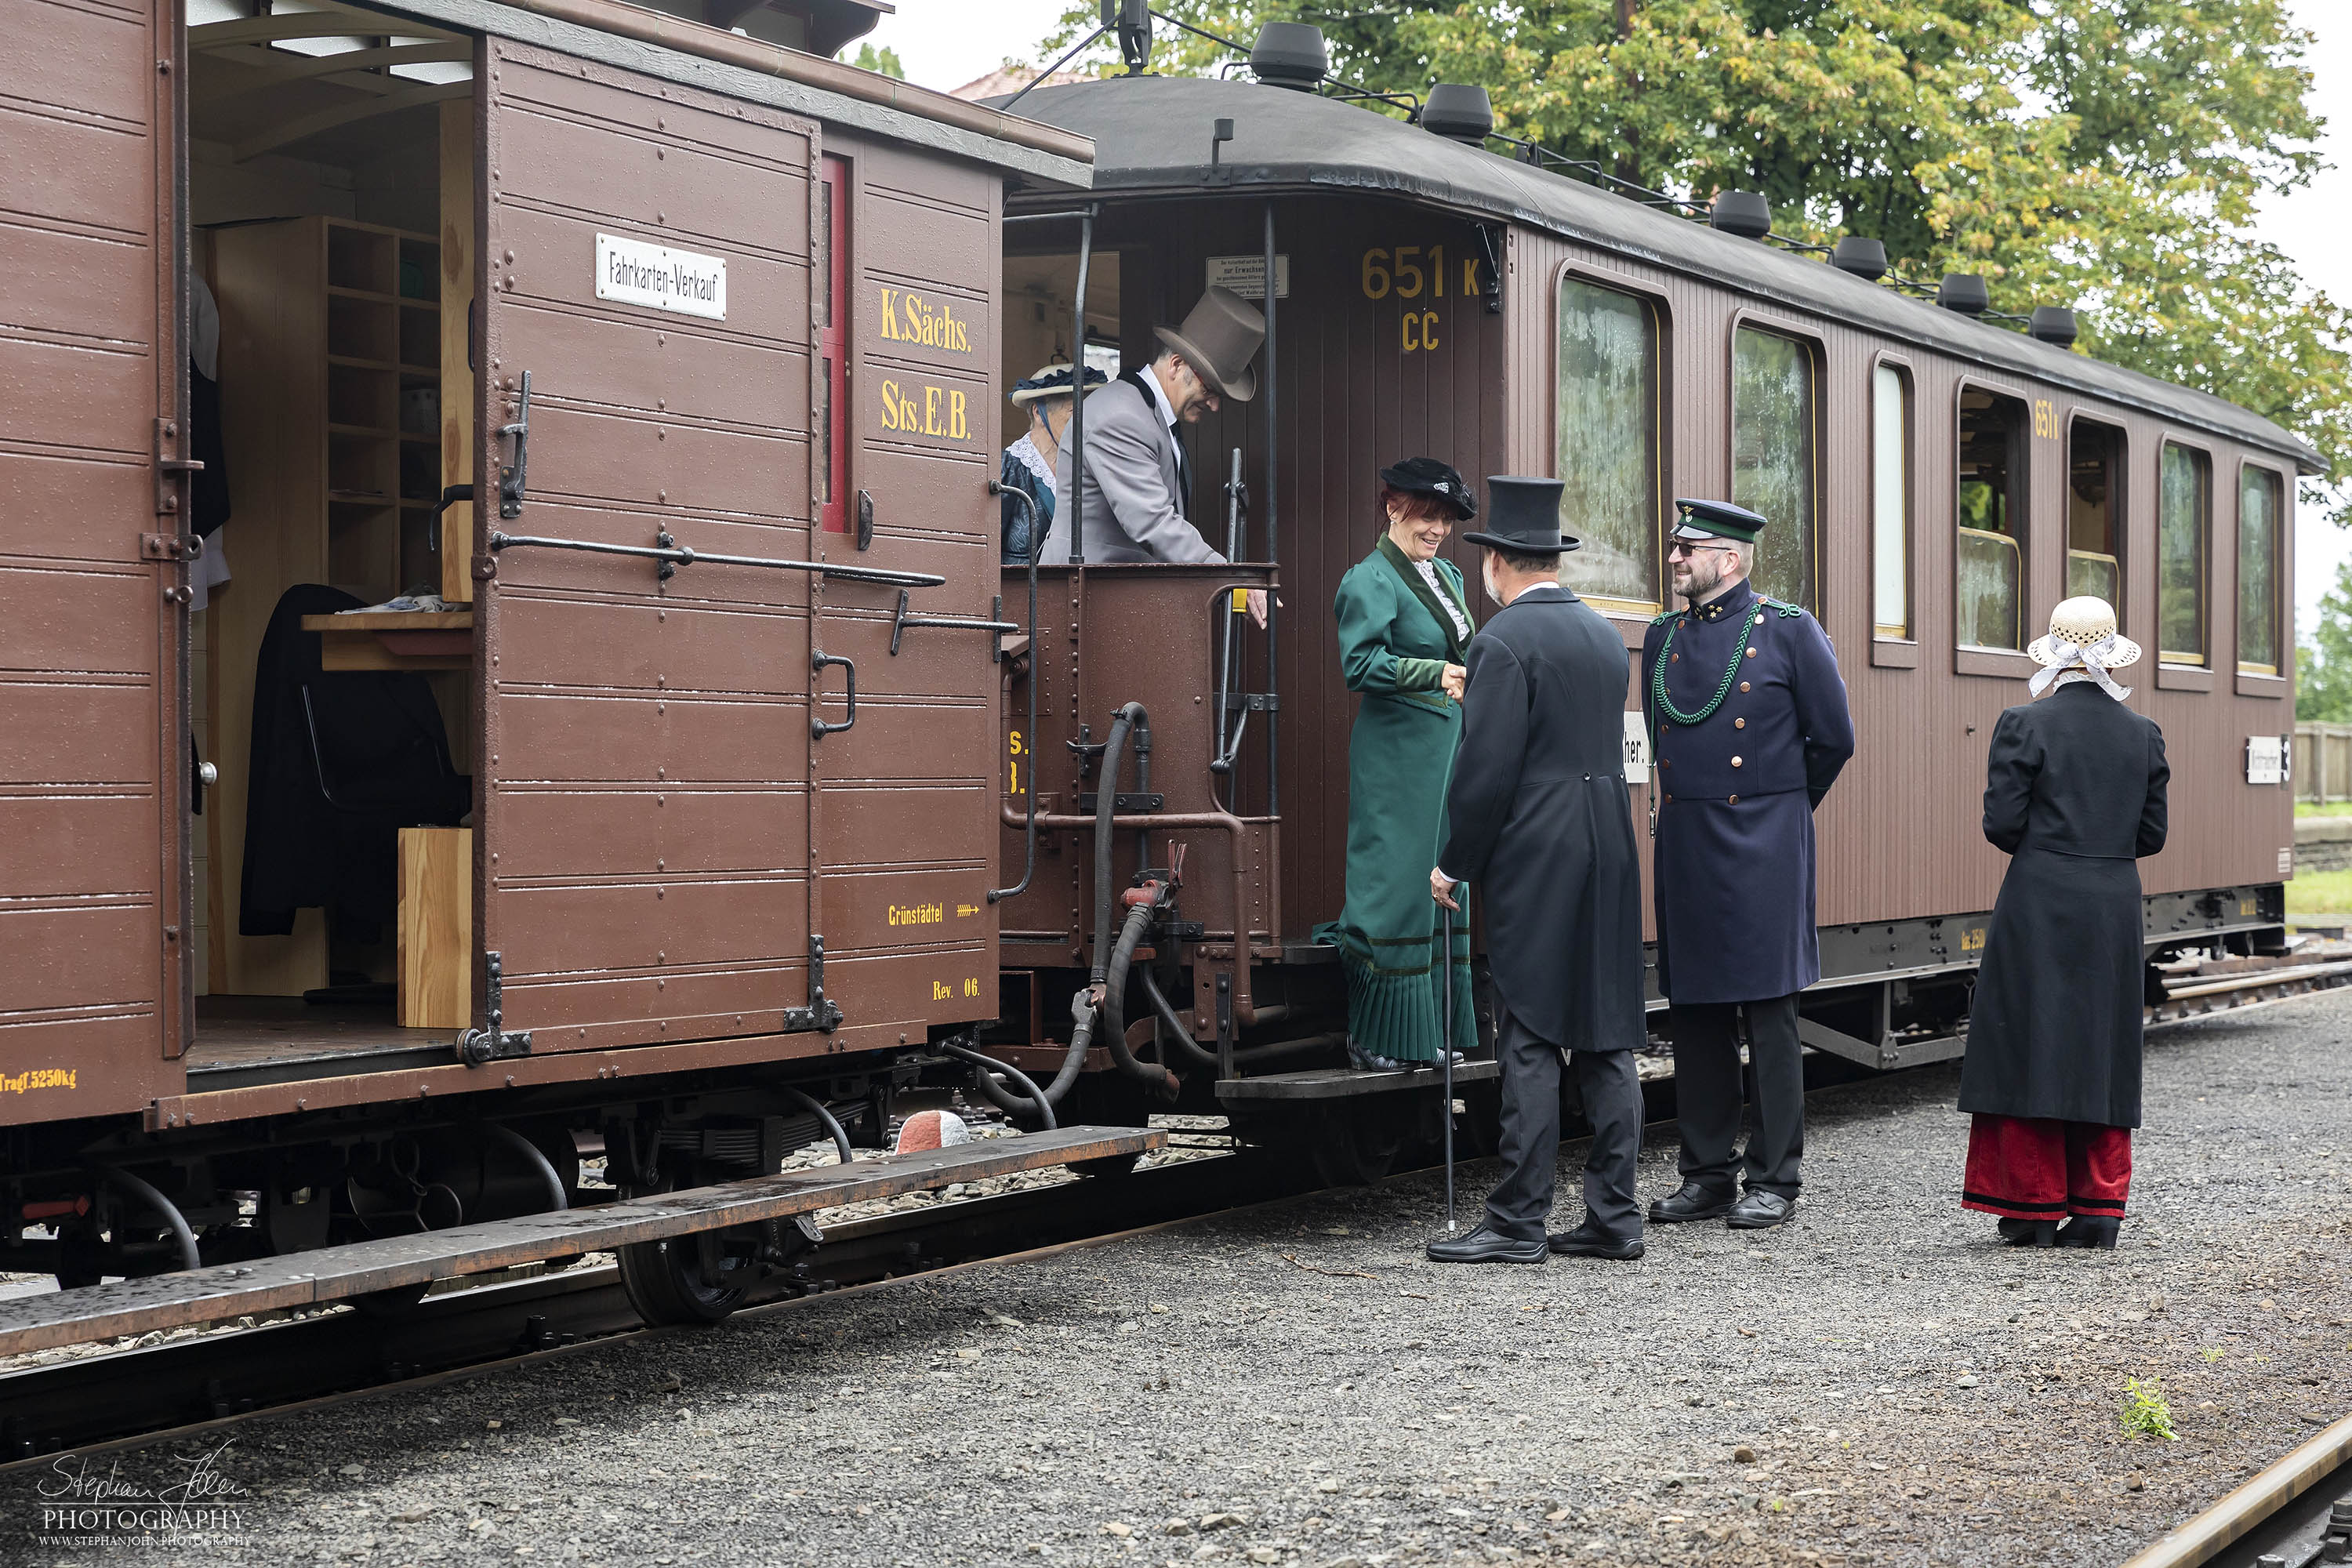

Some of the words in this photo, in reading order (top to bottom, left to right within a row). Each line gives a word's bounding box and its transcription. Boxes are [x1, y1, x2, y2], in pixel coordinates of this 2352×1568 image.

[609, 251, 718, 303] Fahrkarten-Verkauf
[1362, 245, 1443, 299] 651
[1464, 258, 1480, 296] K
[880, 288, 972, 353] K.Sächs.
[1402, 310, 1439, 351] CC
[881, 379, 971, 440] Sts.E.B.
[888, 902, 943, 926] Grünstädtel
[932, 980, 954, 1001] Rev.
[964, 978, 981, 998] 06.
